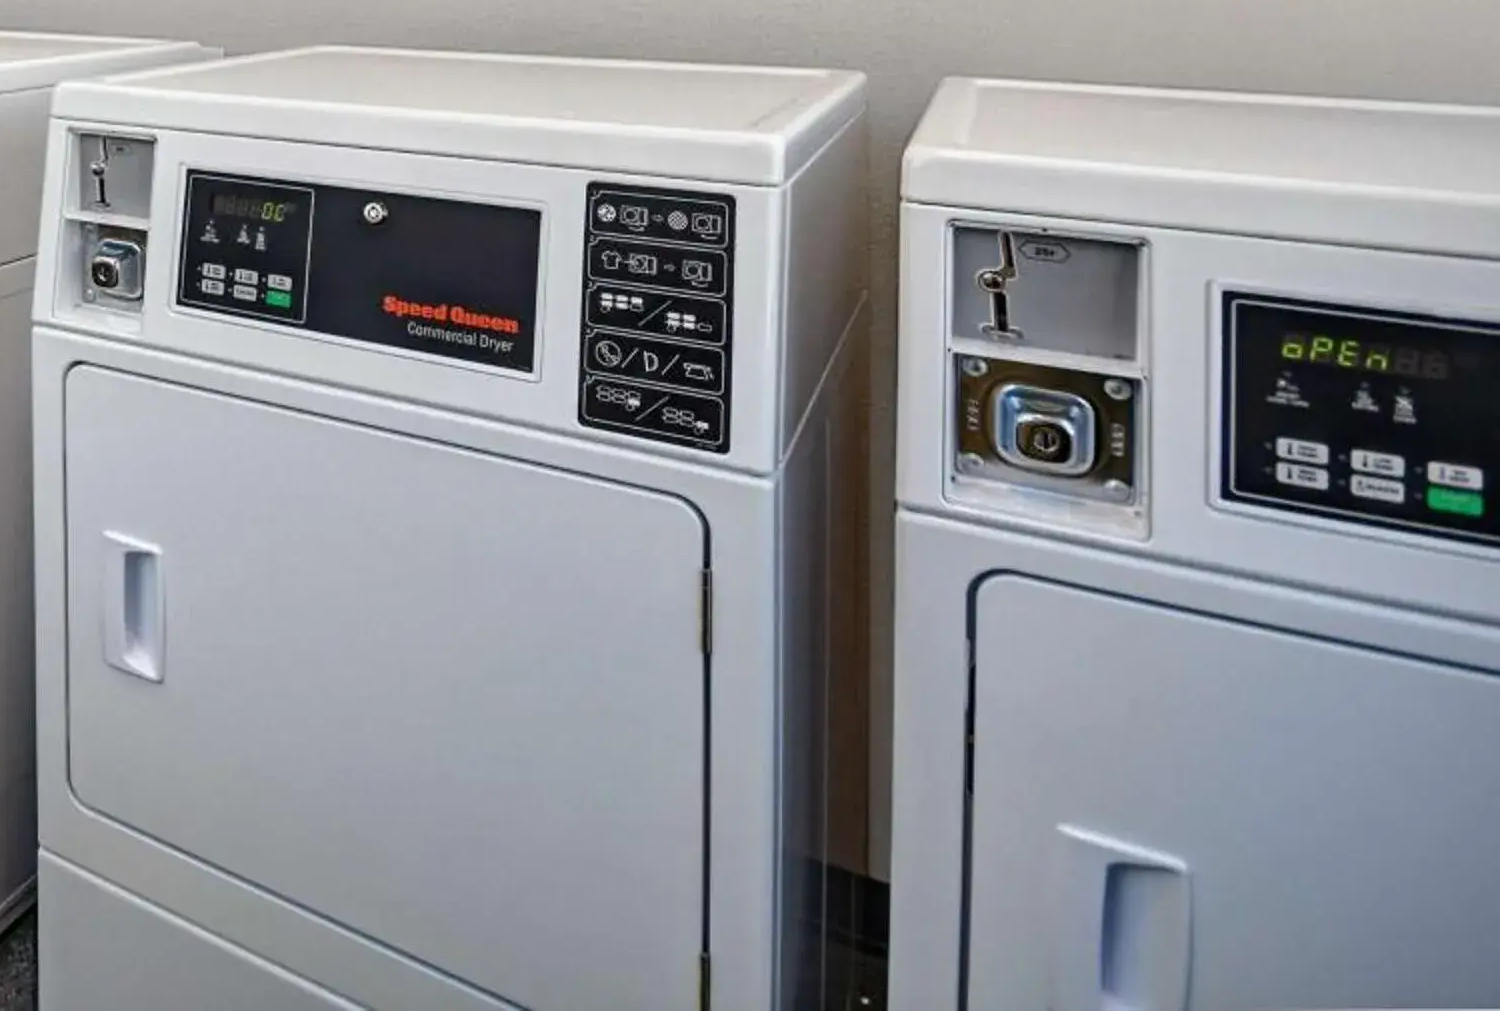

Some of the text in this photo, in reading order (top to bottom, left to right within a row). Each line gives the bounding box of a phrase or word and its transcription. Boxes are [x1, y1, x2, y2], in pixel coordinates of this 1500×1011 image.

[382, 294, 520, 334] Speed Queen
[406, 320, 514, 354] Commercial Dryer
